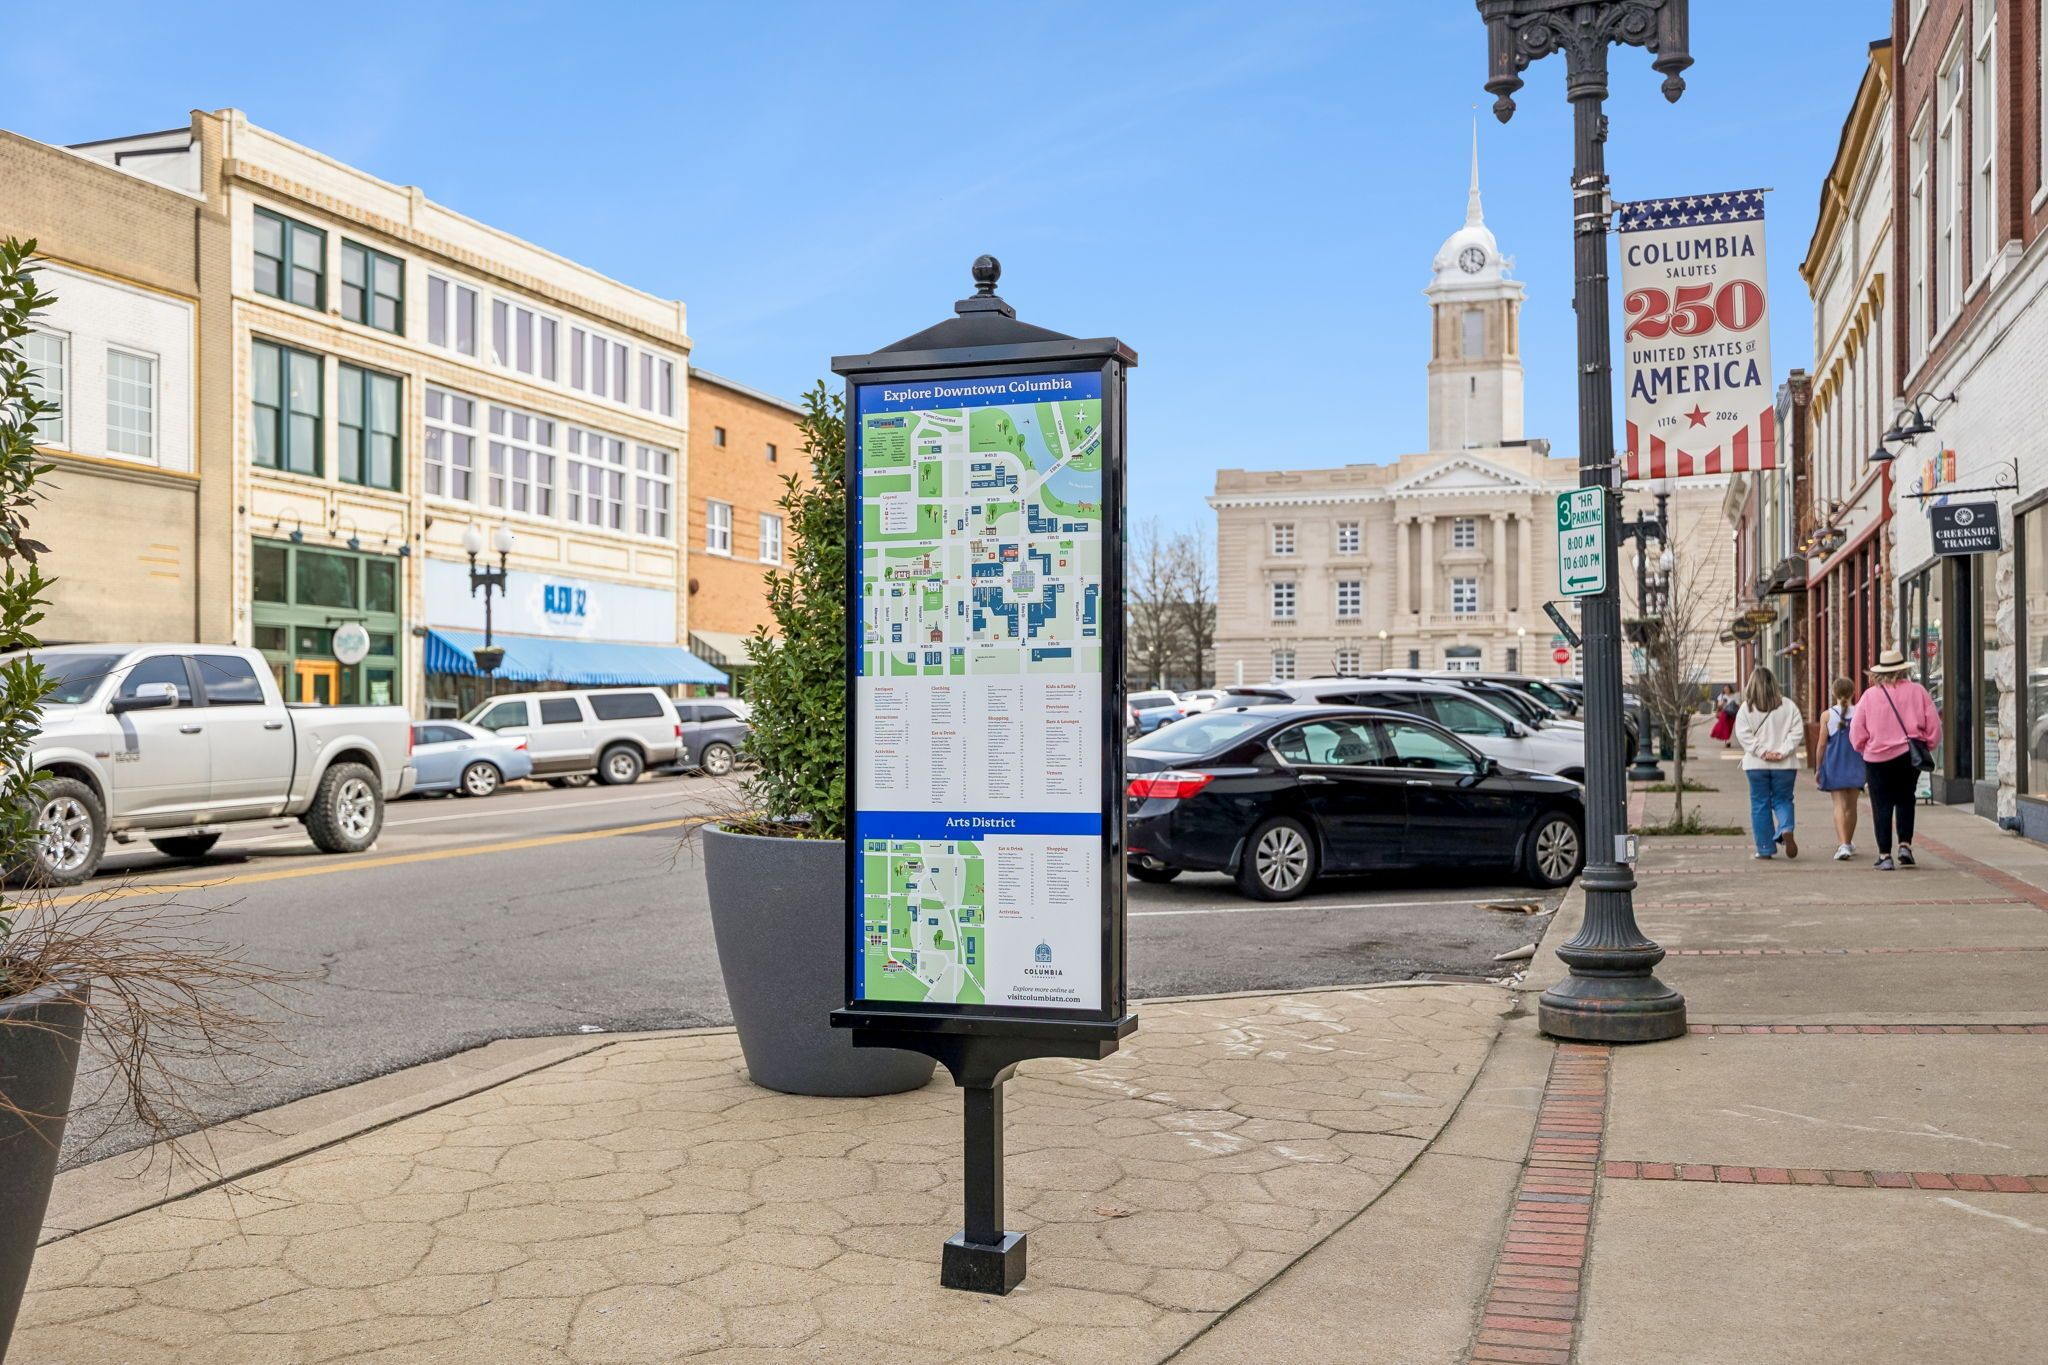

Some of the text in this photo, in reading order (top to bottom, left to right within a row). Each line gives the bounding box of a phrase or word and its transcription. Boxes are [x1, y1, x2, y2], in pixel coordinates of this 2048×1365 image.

[1628, 234, 1756, 267] COLUMBIA
[1666, 264, 1717, 279] SALUTES
[1624, 278, 1766, 343] 250
[1633, 340, 1756, 364] UNITED STATES OF
[1630, 358, 1762, 404] AMERICA
[884, 378, 1072, 402] Explore Downtown Columbia
[1658, 411, 1738, 428] 1776 2026
[1580, 494, 1592, 508] HR
[1560, 501, 1571, 526] 3
[1572, 508, 1600, 525] PARKING
[1936, 526, 1996, 539] CREEKSIDE
[1568, 534, 1595, 551] 8:00 AM
[1942, 537, 1991, 548] TRADING
[1564, 552, 1600, 570] TO 6:00 PM
[1554, 652, 1568, 660] STOP
[946, 817, 1016, 828] Arts District
[1007, 993, 1081, 1002] visitcolumbiatn.com
